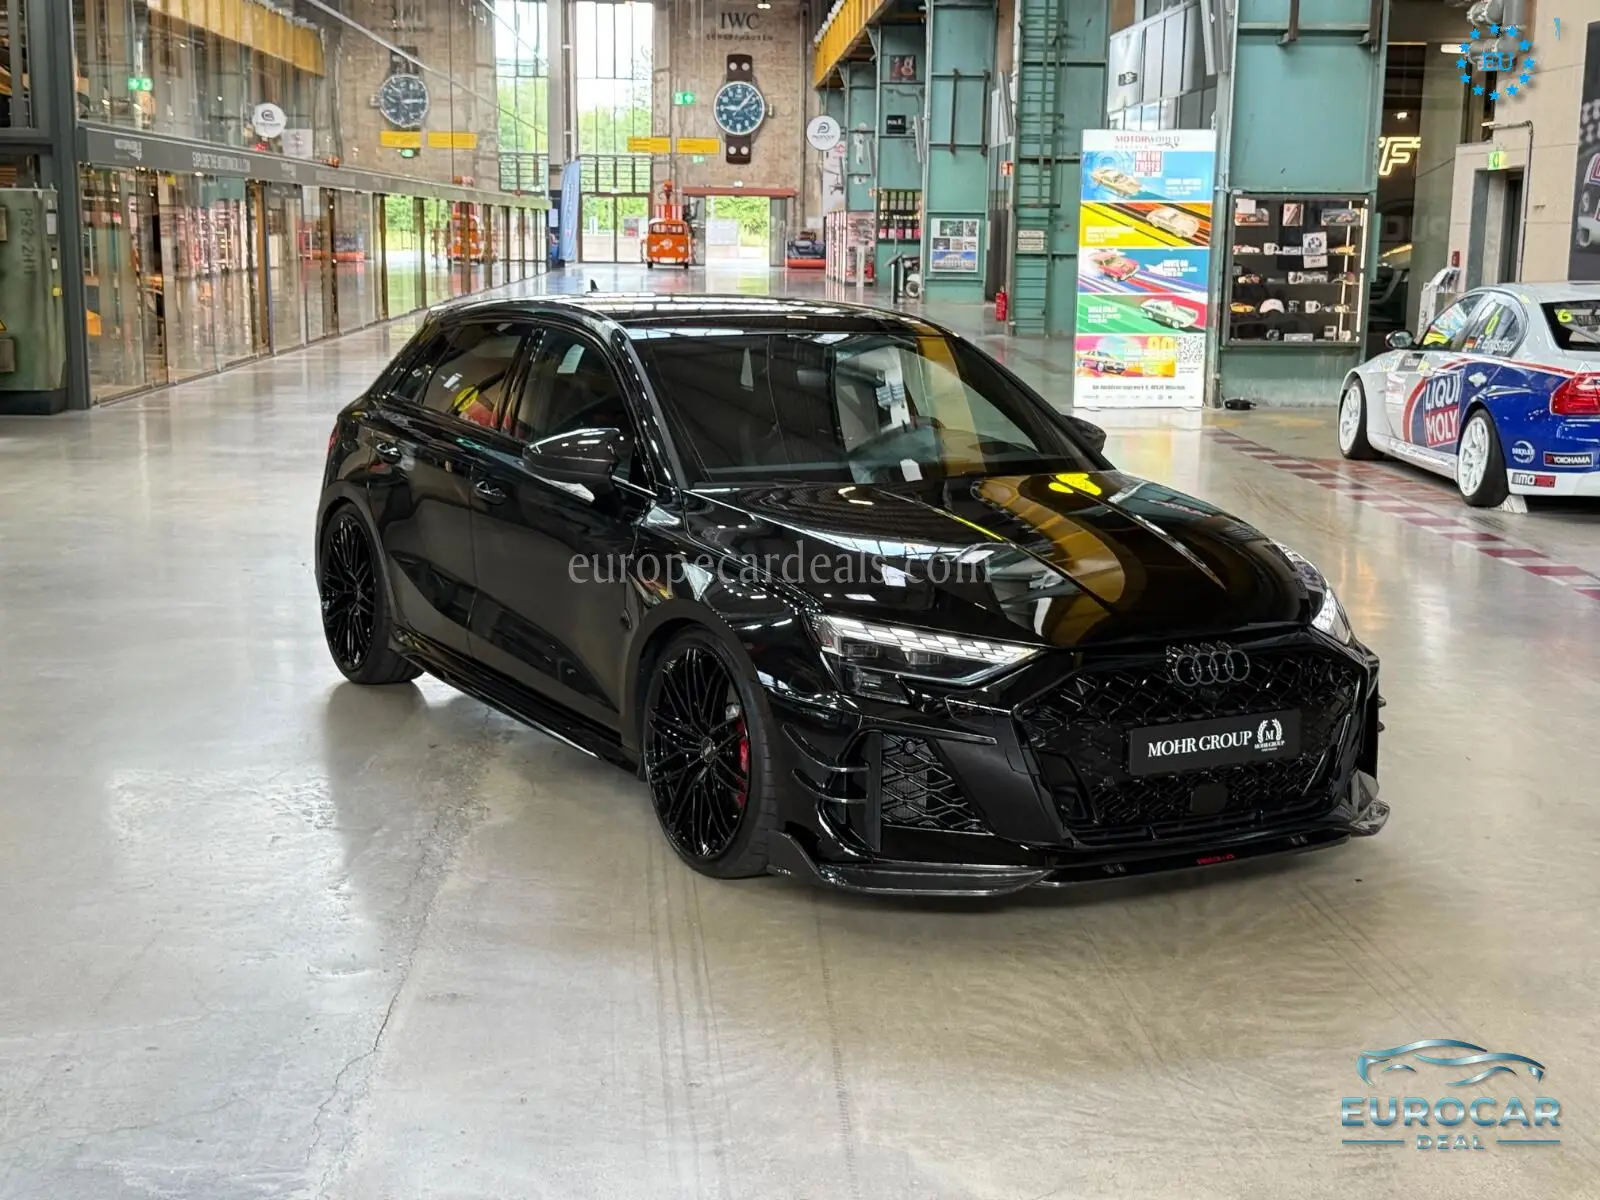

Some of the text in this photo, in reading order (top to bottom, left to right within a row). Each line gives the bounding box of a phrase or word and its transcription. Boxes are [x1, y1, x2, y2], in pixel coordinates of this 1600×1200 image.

[720, 12, 760, 30] IWC
[1425, 374, 1461, 410] LIQUI
[1426, 409, 1459, 444] MOLY
[1552, 455, 1591, 465] YOKOHAMA
[1148, 731, 1253, 758] MOHR GROUP
[1264, 729, 1275, 741] M
